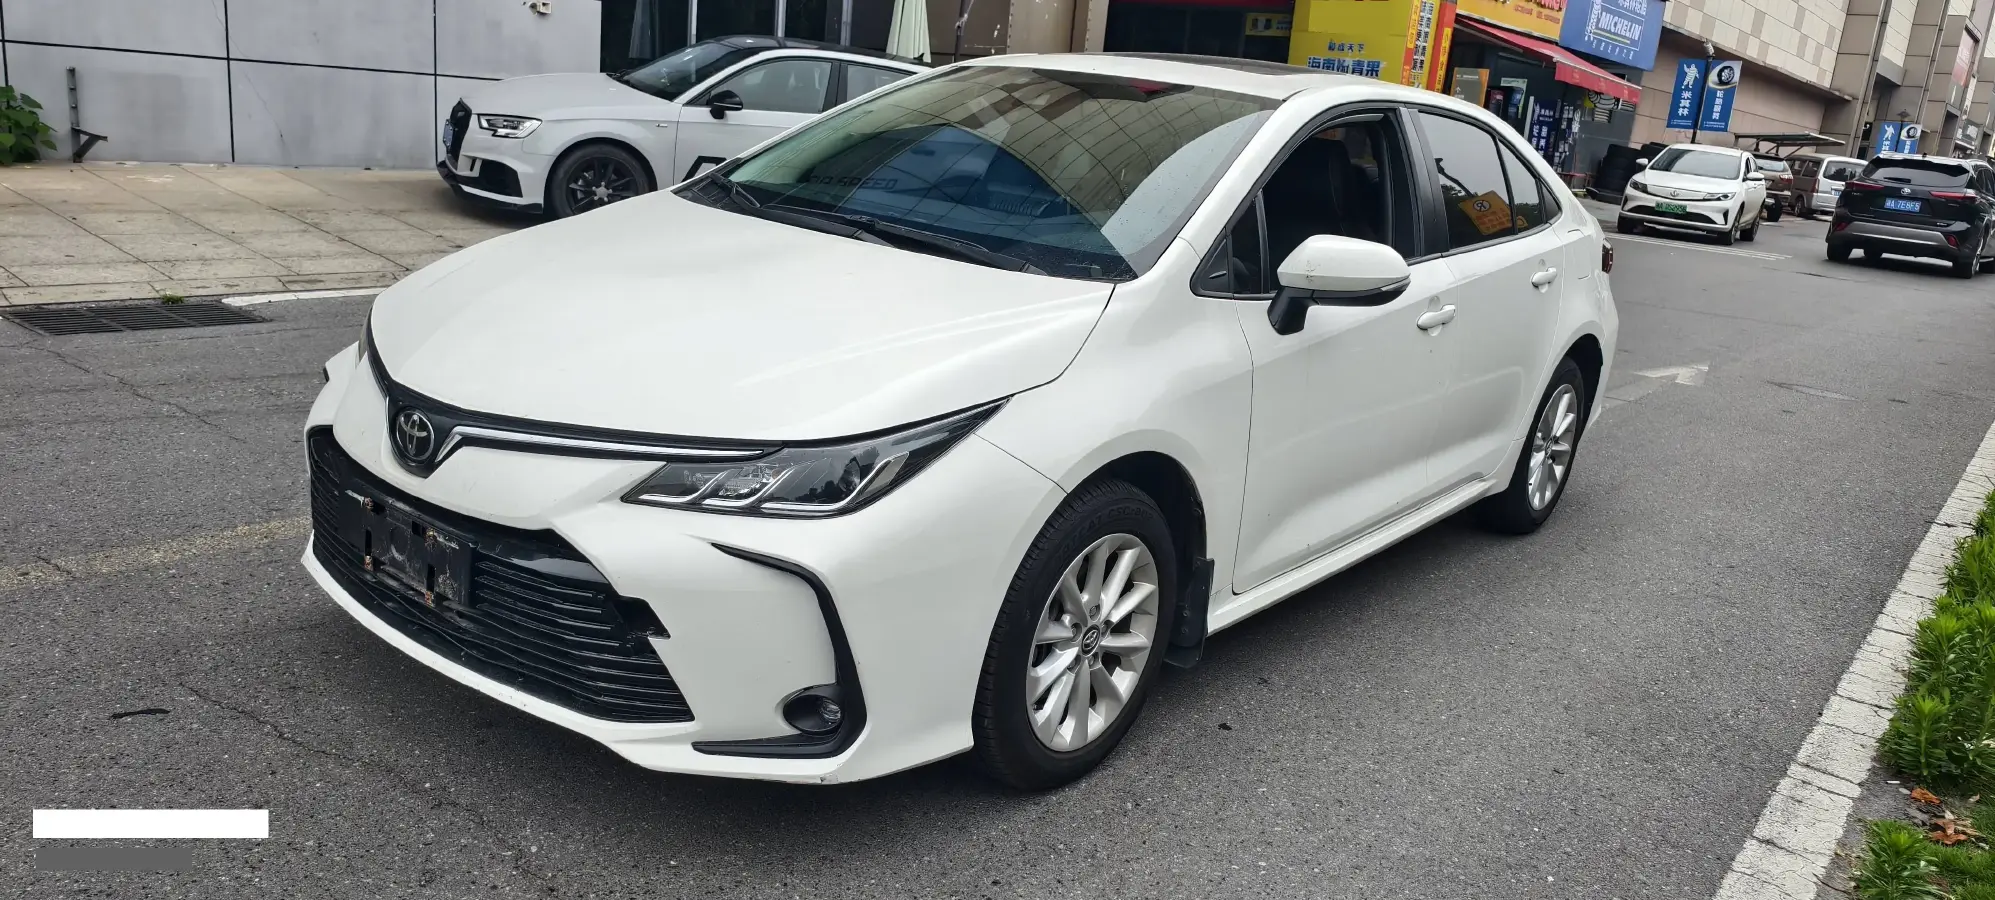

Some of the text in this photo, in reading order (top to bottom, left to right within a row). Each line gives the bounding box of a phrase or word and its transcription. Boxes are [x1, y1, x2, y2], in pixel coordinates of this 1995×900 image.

[1598, 11, 1642, 41] MICHELIN
[1677, 90, 1693, 117] 米其林
